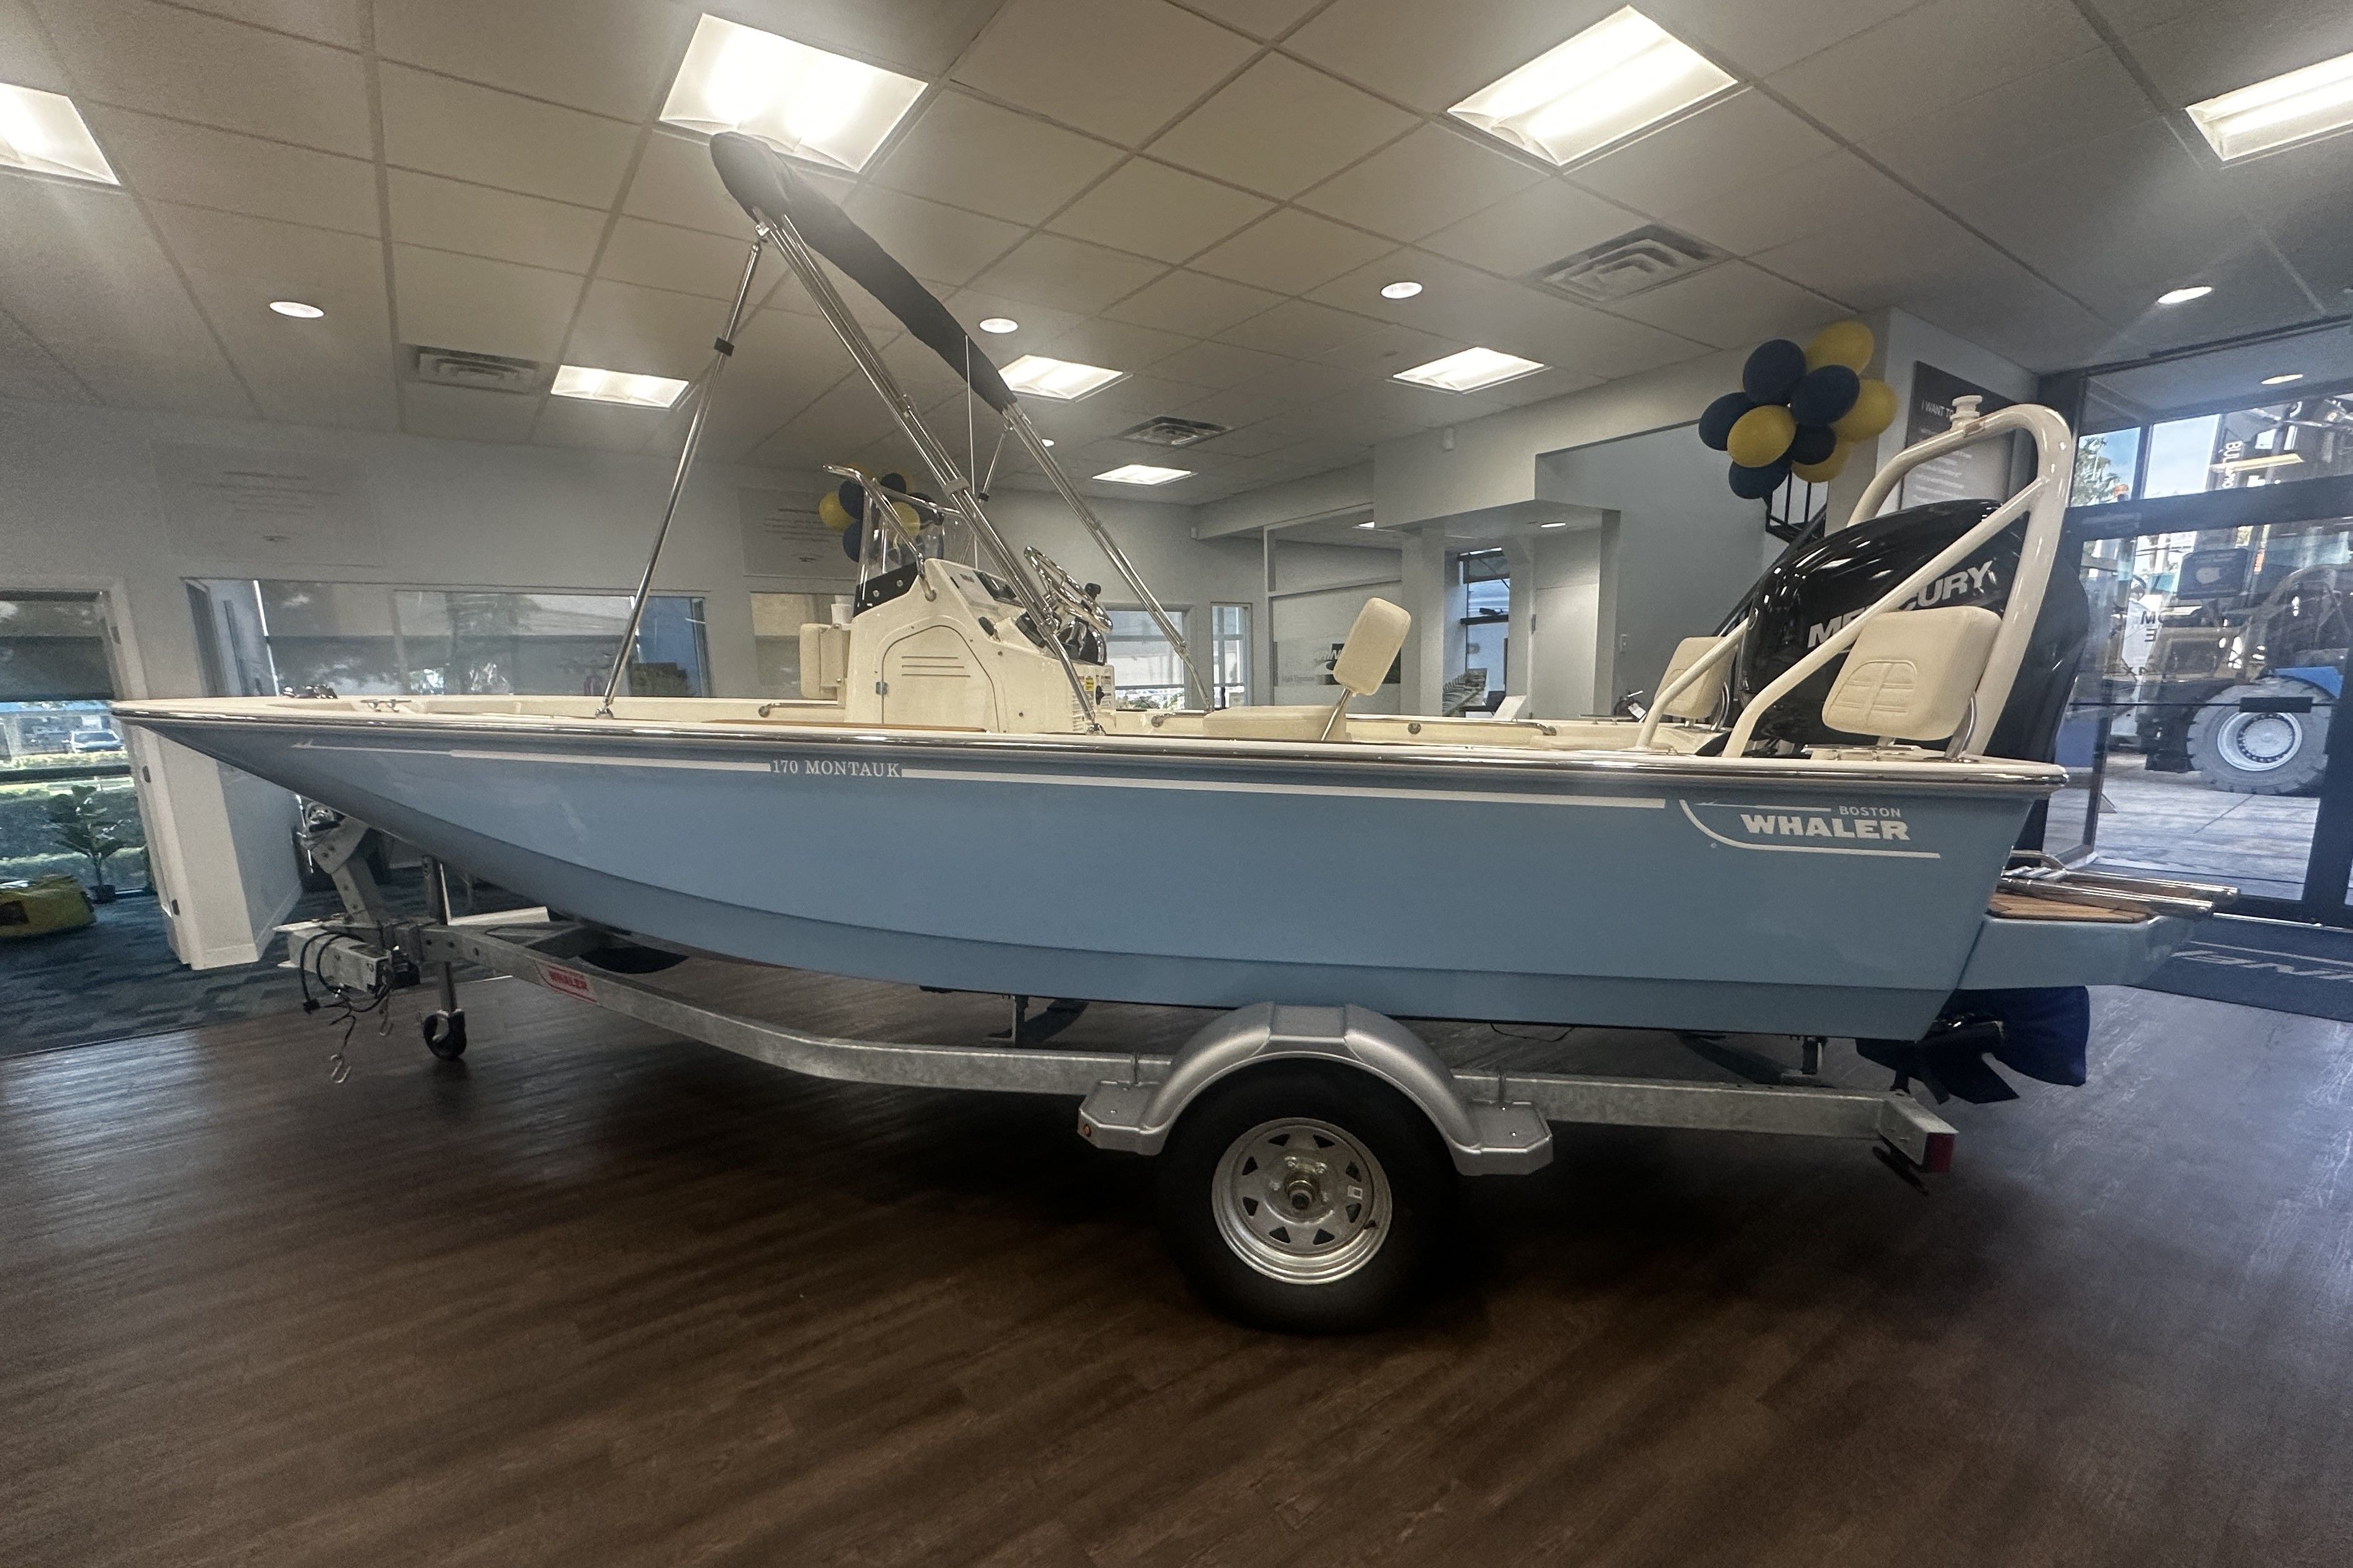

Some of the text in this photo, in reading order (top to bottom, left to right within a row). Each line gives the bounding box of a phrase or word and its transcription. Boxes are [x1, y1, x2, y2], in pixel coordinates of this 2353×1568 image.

[1925, 403, 1945, 418] WANT
[773, 760, 900, 778] 170 MONTAUK
[1839, 805, 1901, 818] BOSTON
[1740, 813, 1911, 841] WHALER
